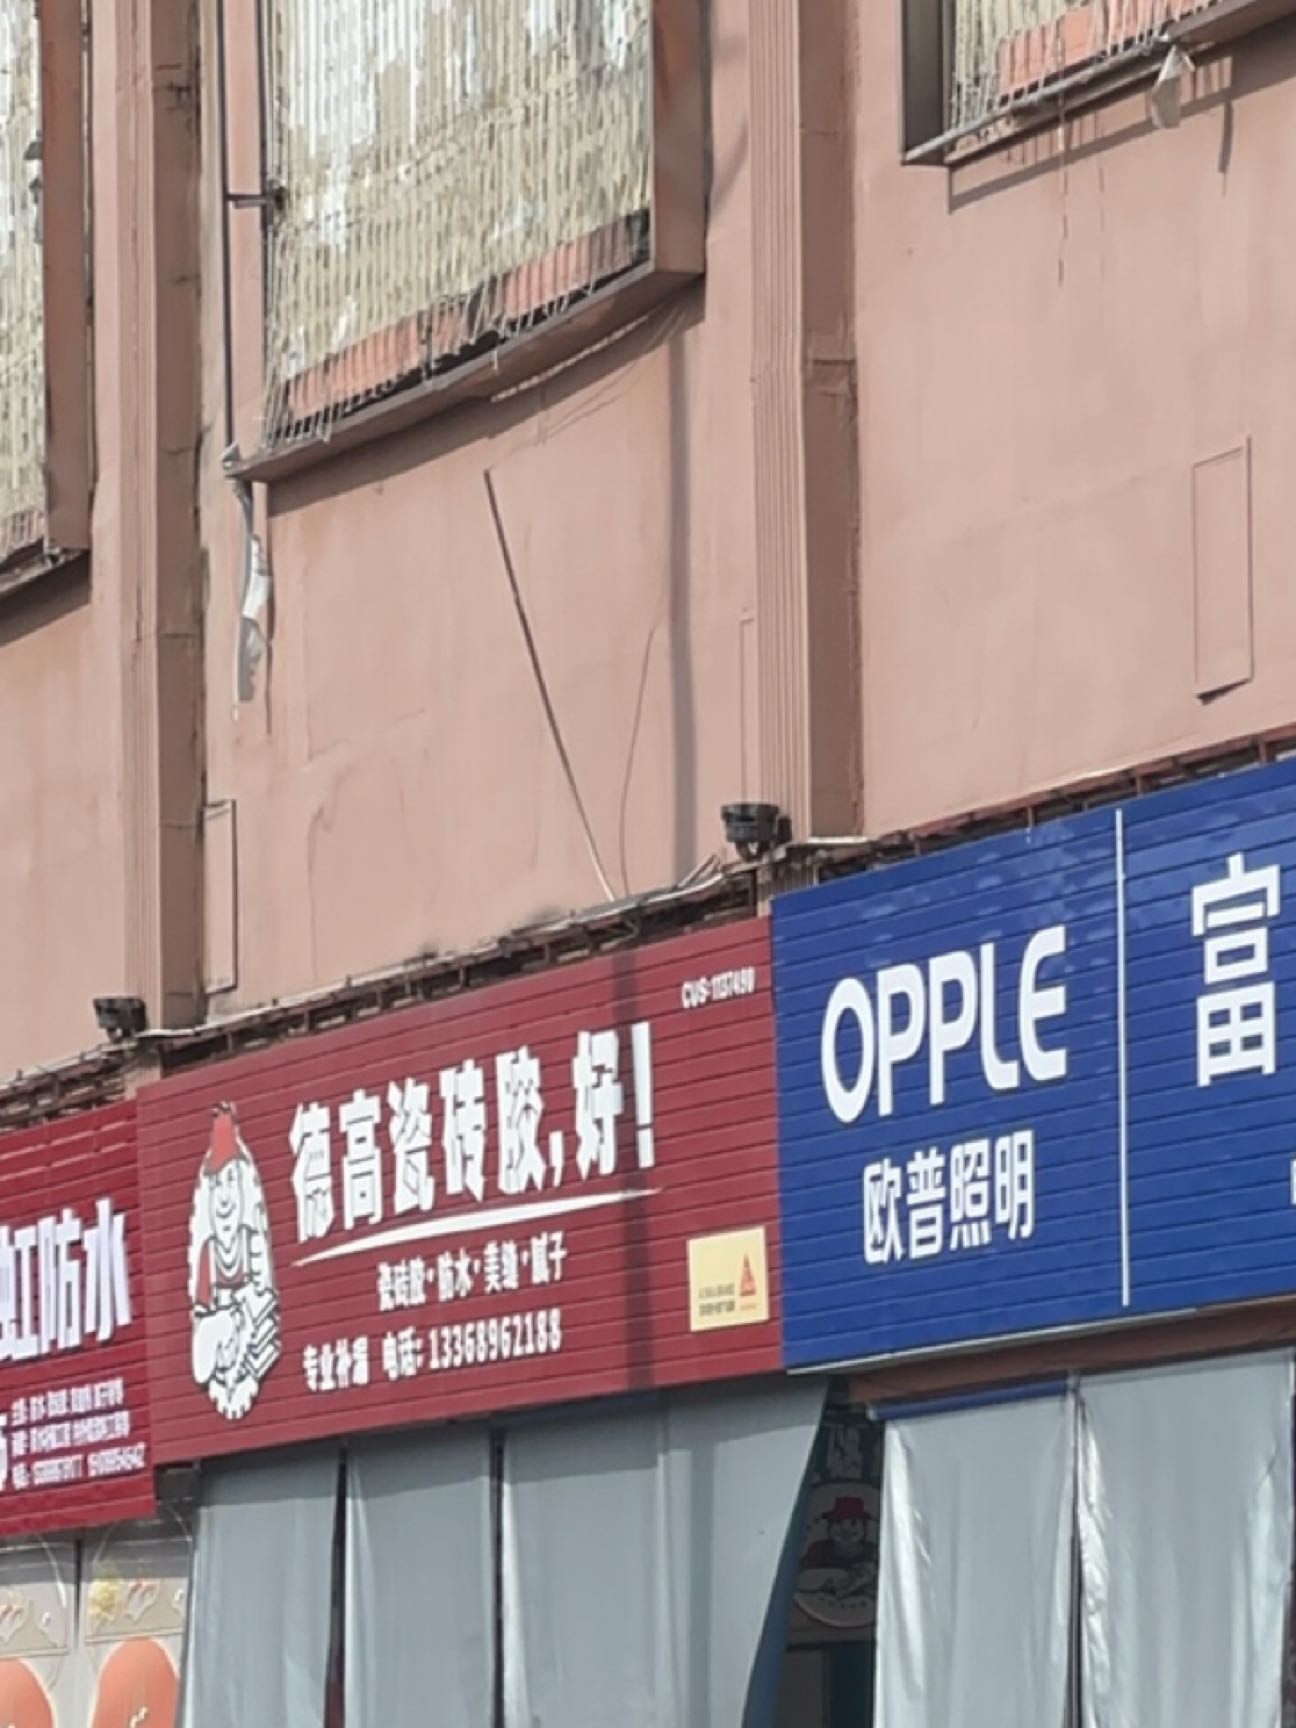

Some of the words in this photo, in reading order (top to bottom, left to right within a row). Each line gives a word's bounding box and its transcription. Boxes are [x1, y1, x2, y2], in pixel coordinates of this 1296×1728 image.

[821, 925, 1066, 1123] OPPLE
[864, 1129, 1034, 1265] 欧普照明
